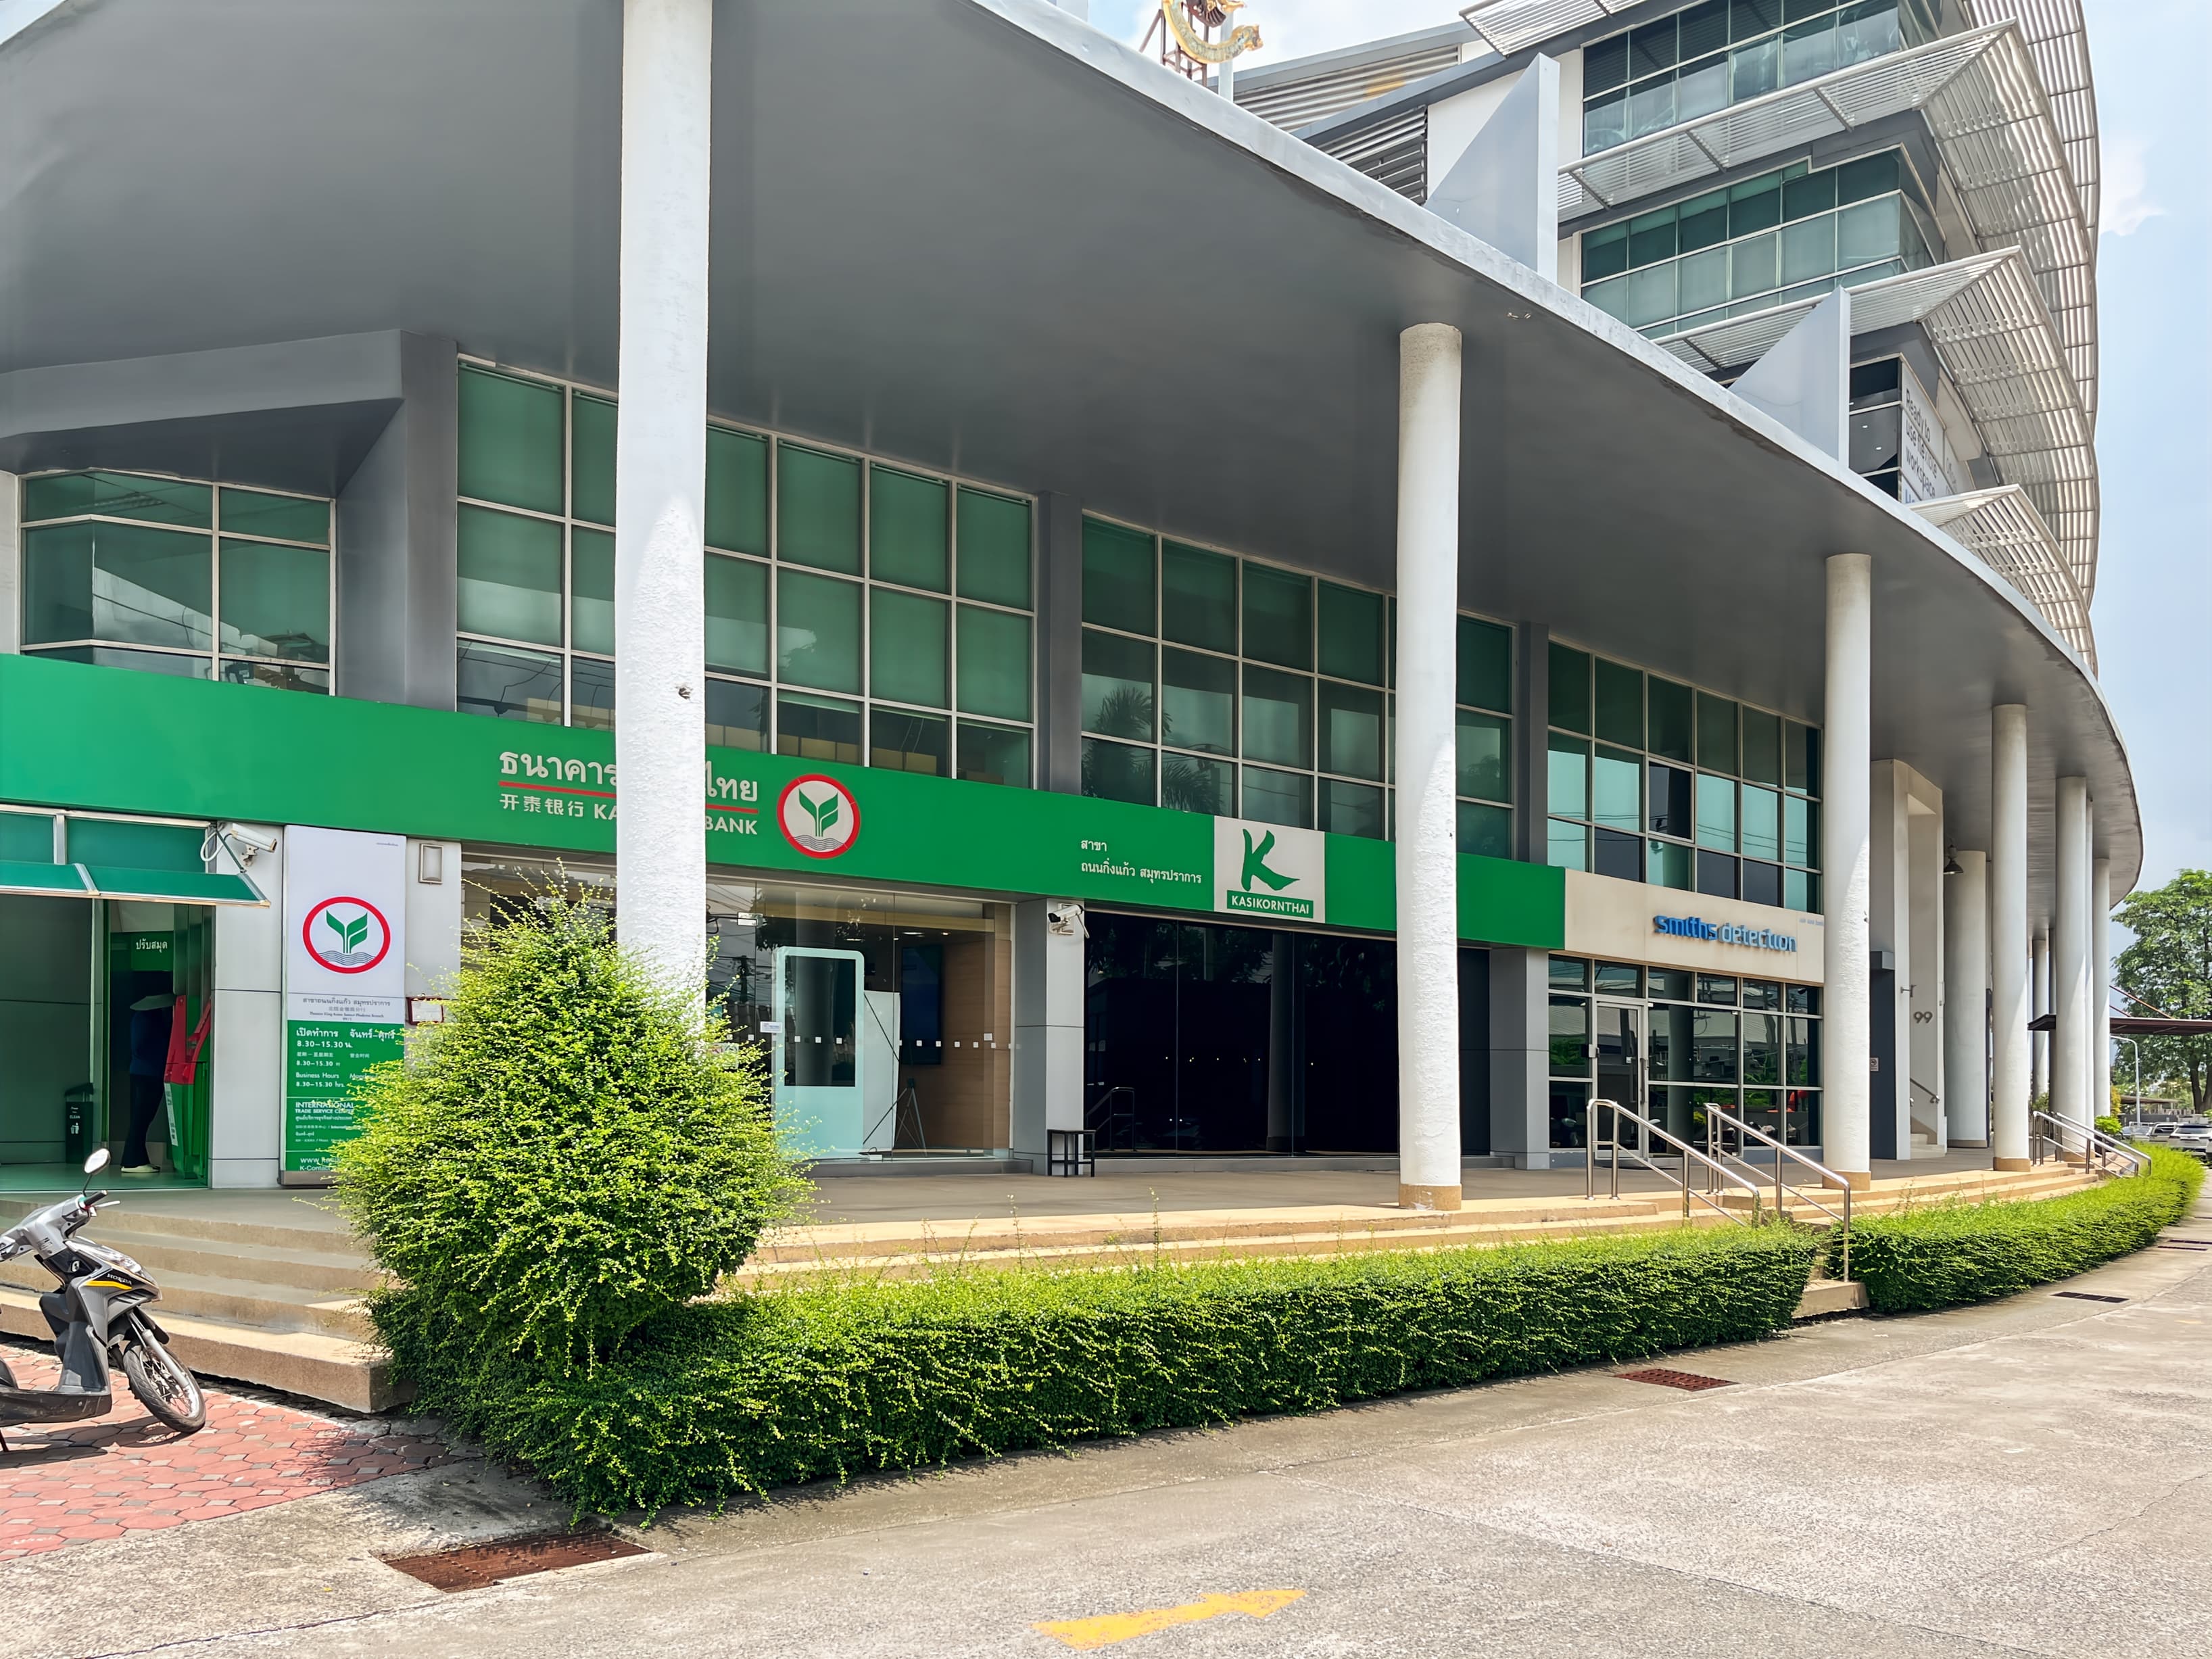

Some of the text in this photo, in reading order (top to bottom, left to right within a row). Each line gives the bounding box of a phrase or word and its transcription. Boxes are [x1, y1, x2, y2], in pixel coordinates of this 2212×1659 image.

[1906, 388, 1931, 443] Ready to
[1906, 418, 1917, 446] use
[1906, 446, 1936, 499] workspace
[500, 794, 584, 817] 开泰银行
[1081, 840, 1107, 852] สาขา
[1081, 857, 1202, 884] ถนนกิ่งแก้ว สมุทรปราการ
[1232, 895, 1309, 914] KASIKORNTHAI
[1653, 915, 1797, 953] smiths detection
[136, 938, 168, 953] ปรับสมุด
[1914, 1011, 1933, 1024] 99
[296, 1027, 339, 1037] เปิดทำการ
[107, 1273, 133, 1286] HONDA
